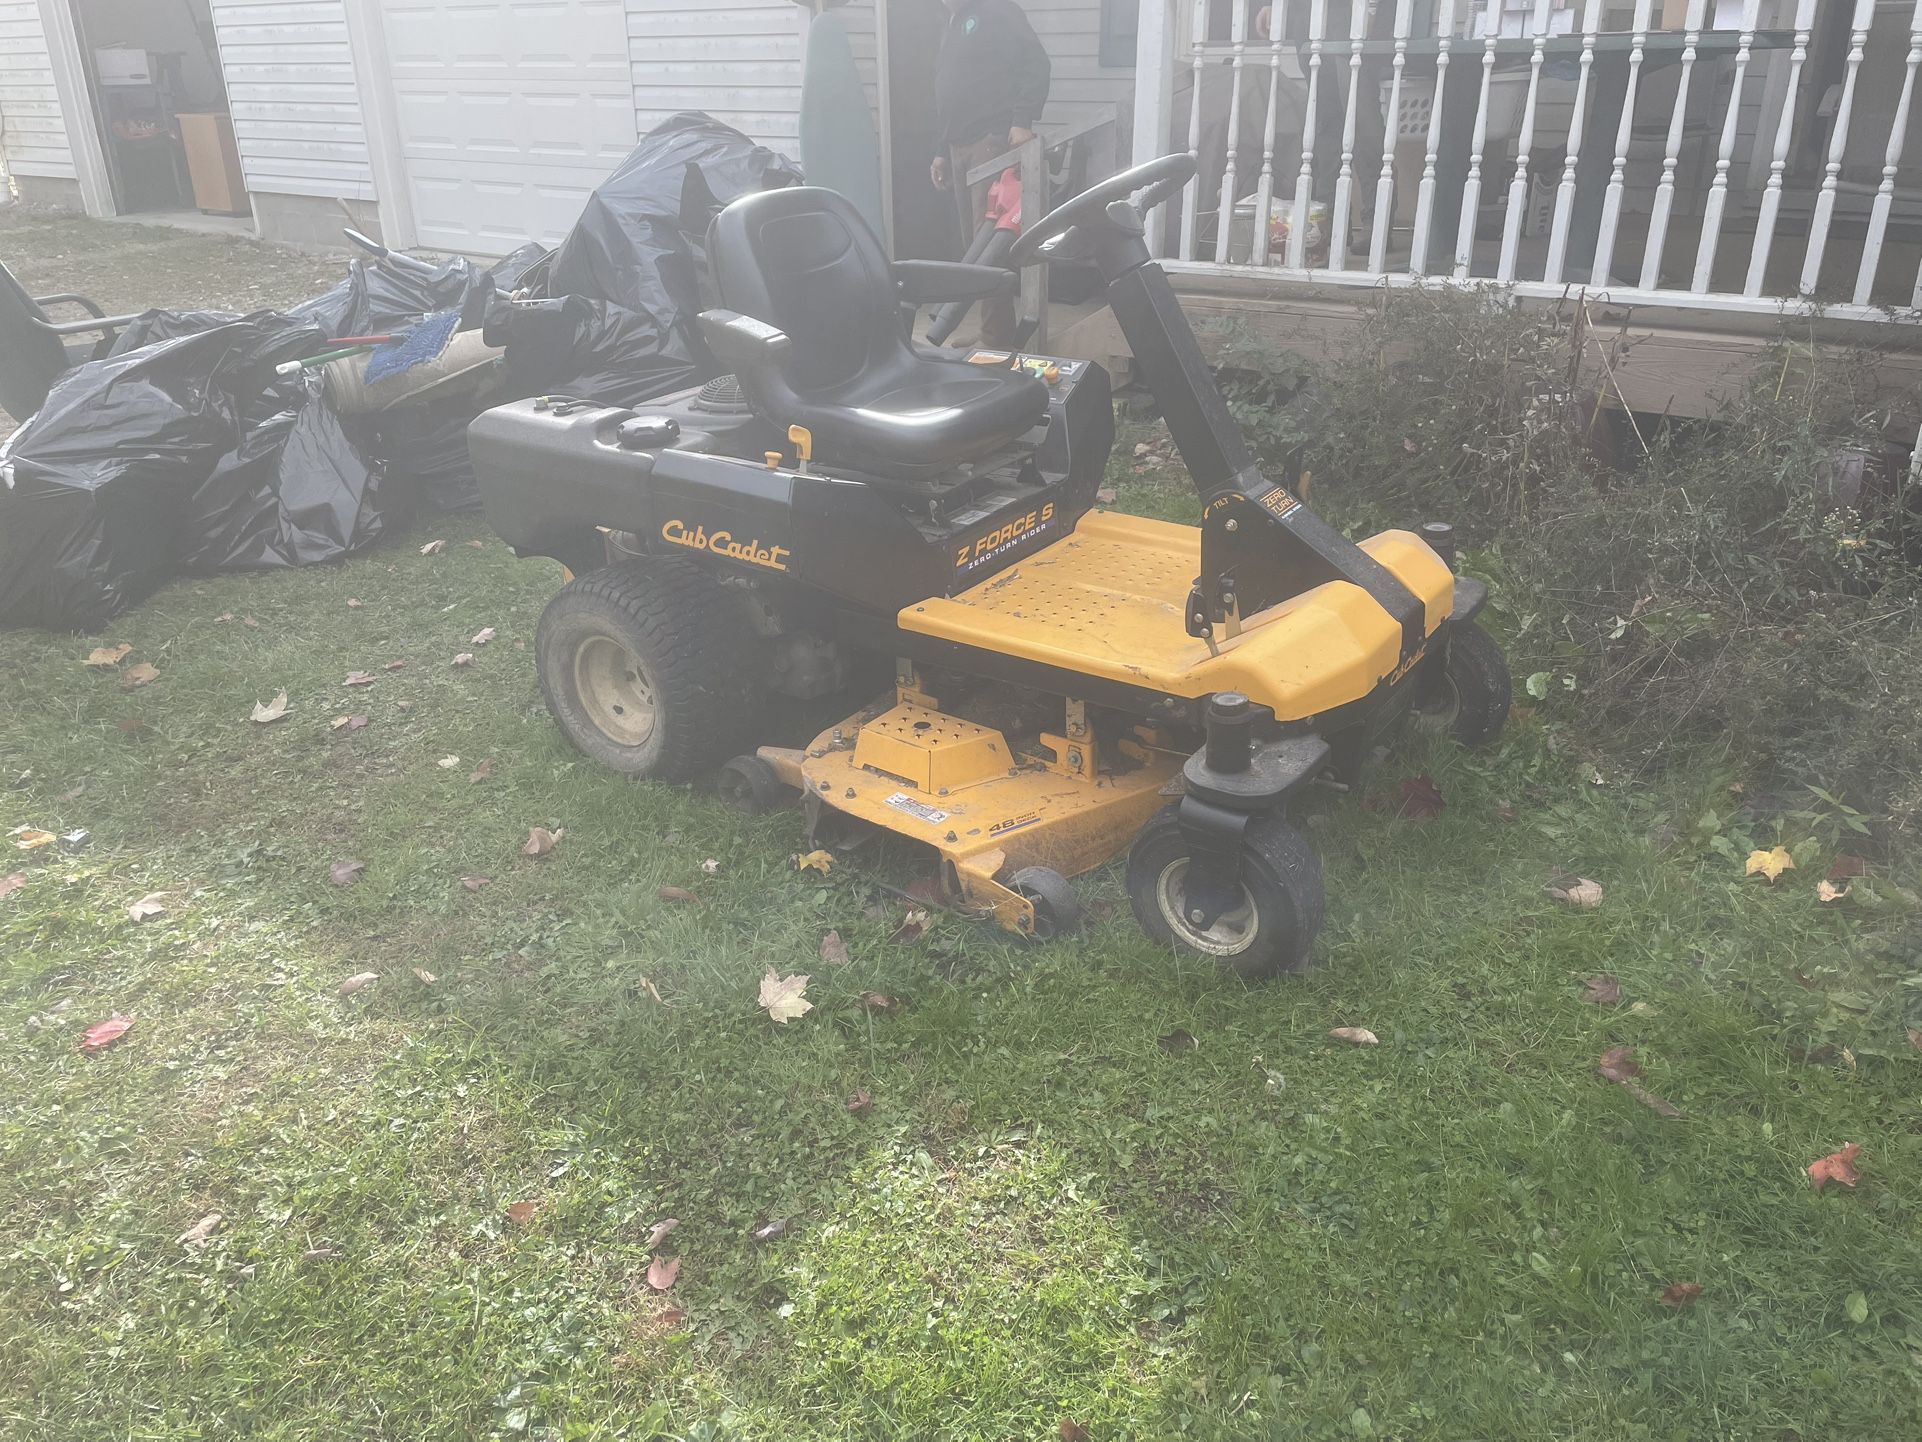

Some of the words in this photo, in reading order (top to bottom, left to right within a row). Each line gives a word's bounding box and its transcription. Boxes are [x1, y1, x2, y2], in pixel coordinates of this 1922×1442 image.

[1213, 498, 1229, 510] TILT
[1264, 489, 1286, 507] ZERO
[1271, 496, 1294, 513] TURN
[956, 545, 970, 567] Z
[975, 511, 1037, 556] FORCE
[1041, 502, 1054, 521] S
[1021, 523, 1046, 541] RIDER
[662, 519, 707, 549] Cub
[708, 531, 790, 571] Cadet
[988, 819, 1015, 833] 48
